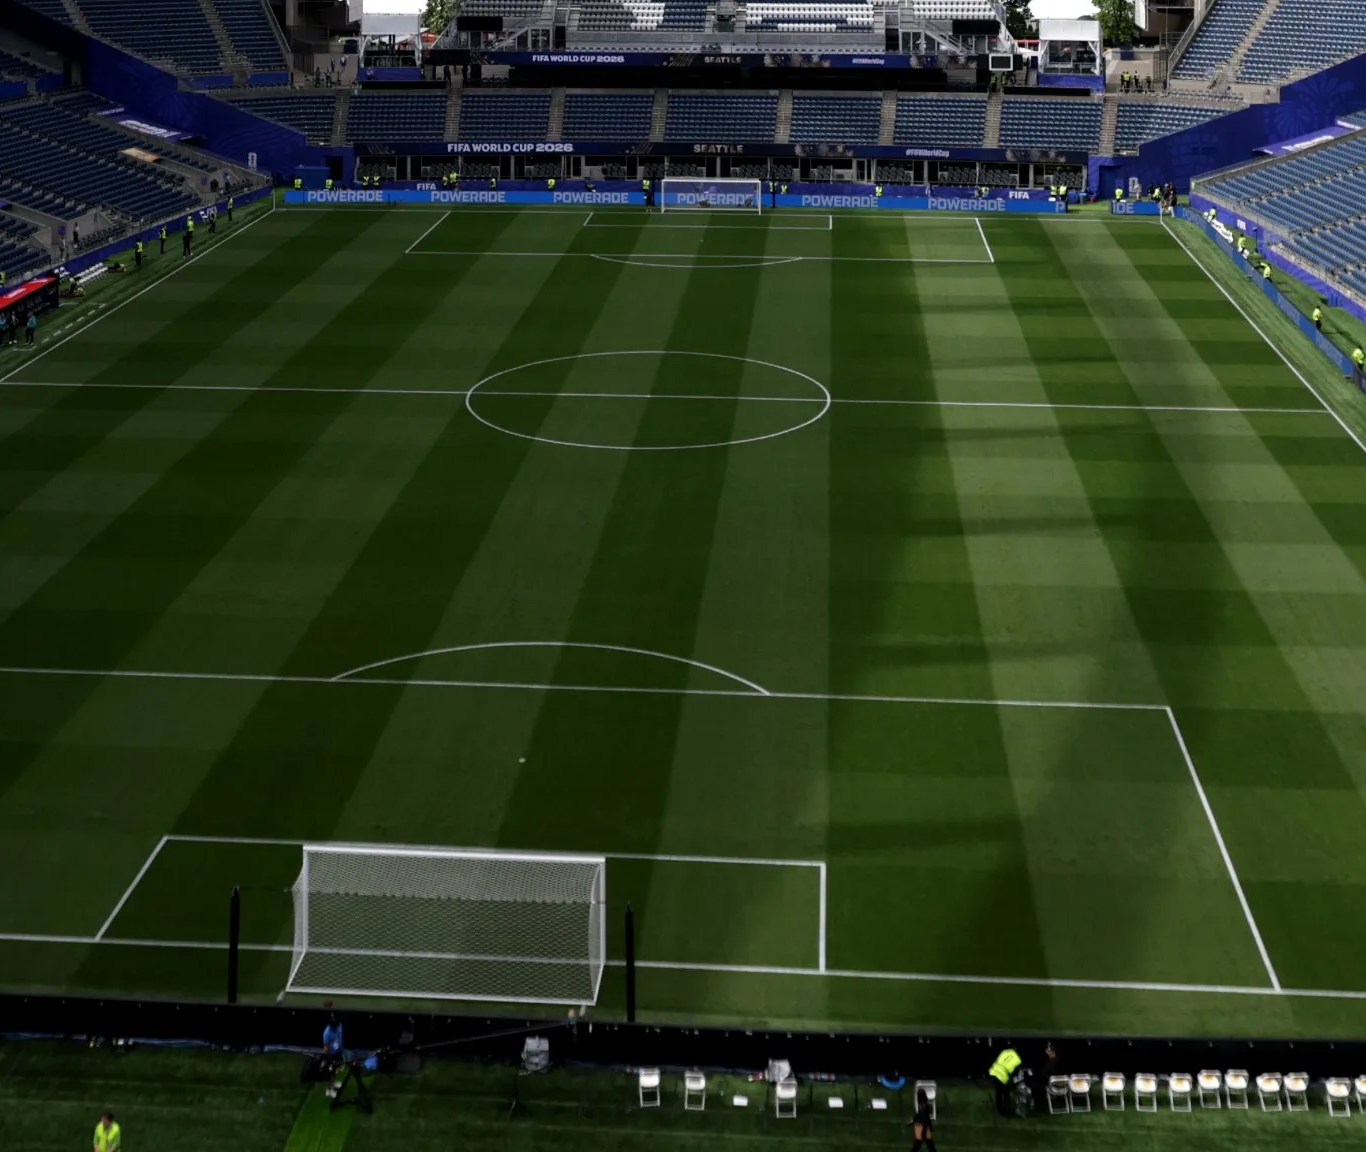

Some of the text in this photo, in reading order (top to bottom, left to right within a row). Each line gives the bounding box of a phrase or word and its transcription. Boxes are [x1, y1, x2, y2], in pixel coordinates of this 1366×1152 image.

[532, 54, 625, 64] FIFA WORLD CUP 2026
[704, 56, 742, 64] SEATTLE
[447, 143, 574, 153] FIFA WORLD CUP 2026
[693, 144, 744, 154] SEATTLE
[416, 183, 437, 191] FIFA
[307, 190, 384, 202] POWERADE
[431, 191, 506, 203] POWERADE
[553, 192, 629, 204] POWERADE
[1009, 190, 1030, 200] FIFA
[801, 196, 878, 208] POWERADE
[927, 198, 1006, 211] POWERADE
